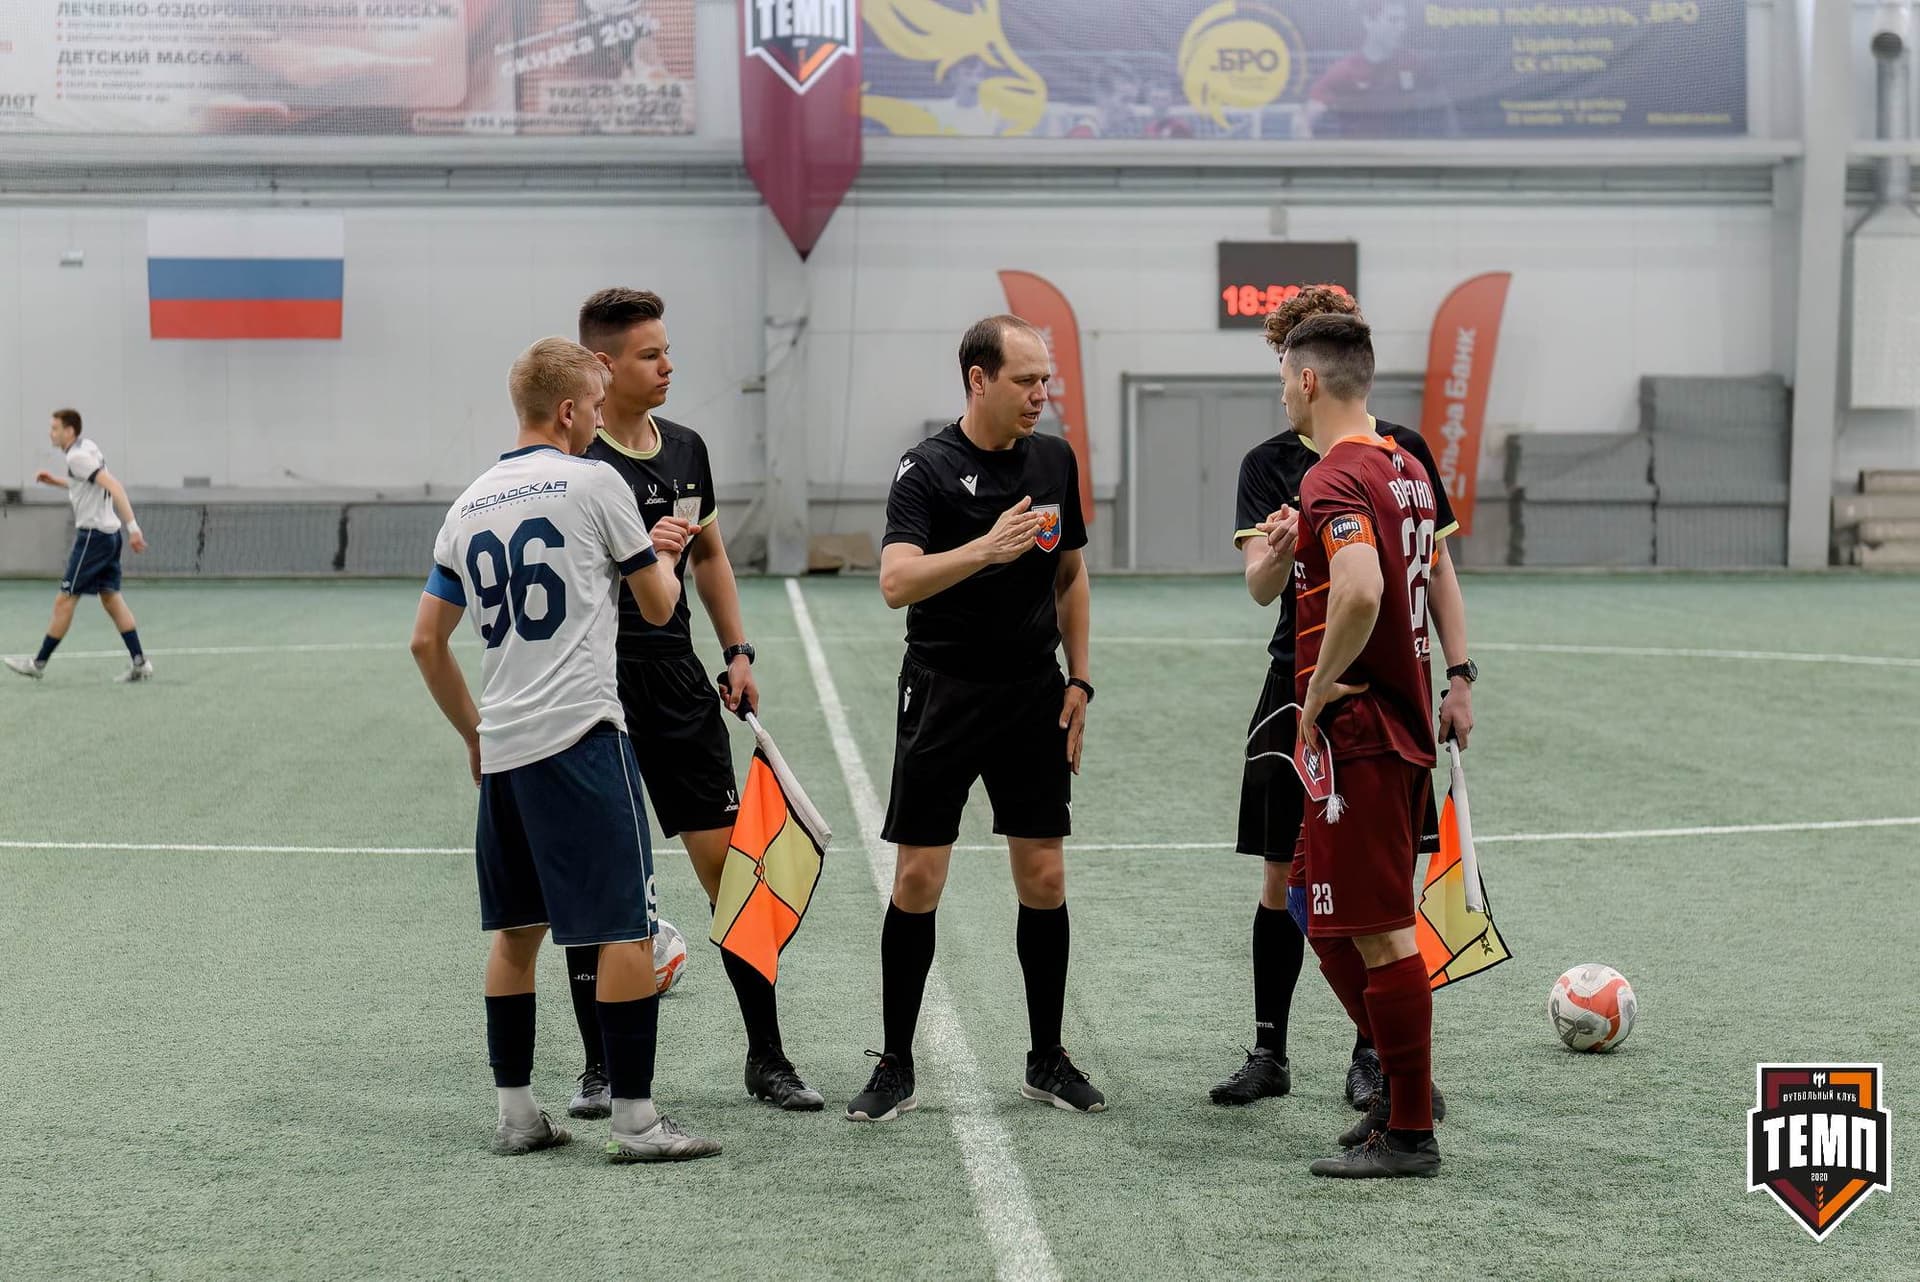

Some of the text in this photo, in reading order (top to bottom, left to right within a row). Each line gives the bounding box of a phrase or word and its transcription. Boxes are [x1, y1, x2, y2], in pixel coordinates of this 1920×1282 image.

[756, 0, 844, 39] ТЕМП
[57, 48, 150, 65] ДЕТСКИЙ
[1333, 521, 1359, 537] ТЕМП
[466, 517, 567, 649] 96
[1312, 883, 1334, 915] 23
